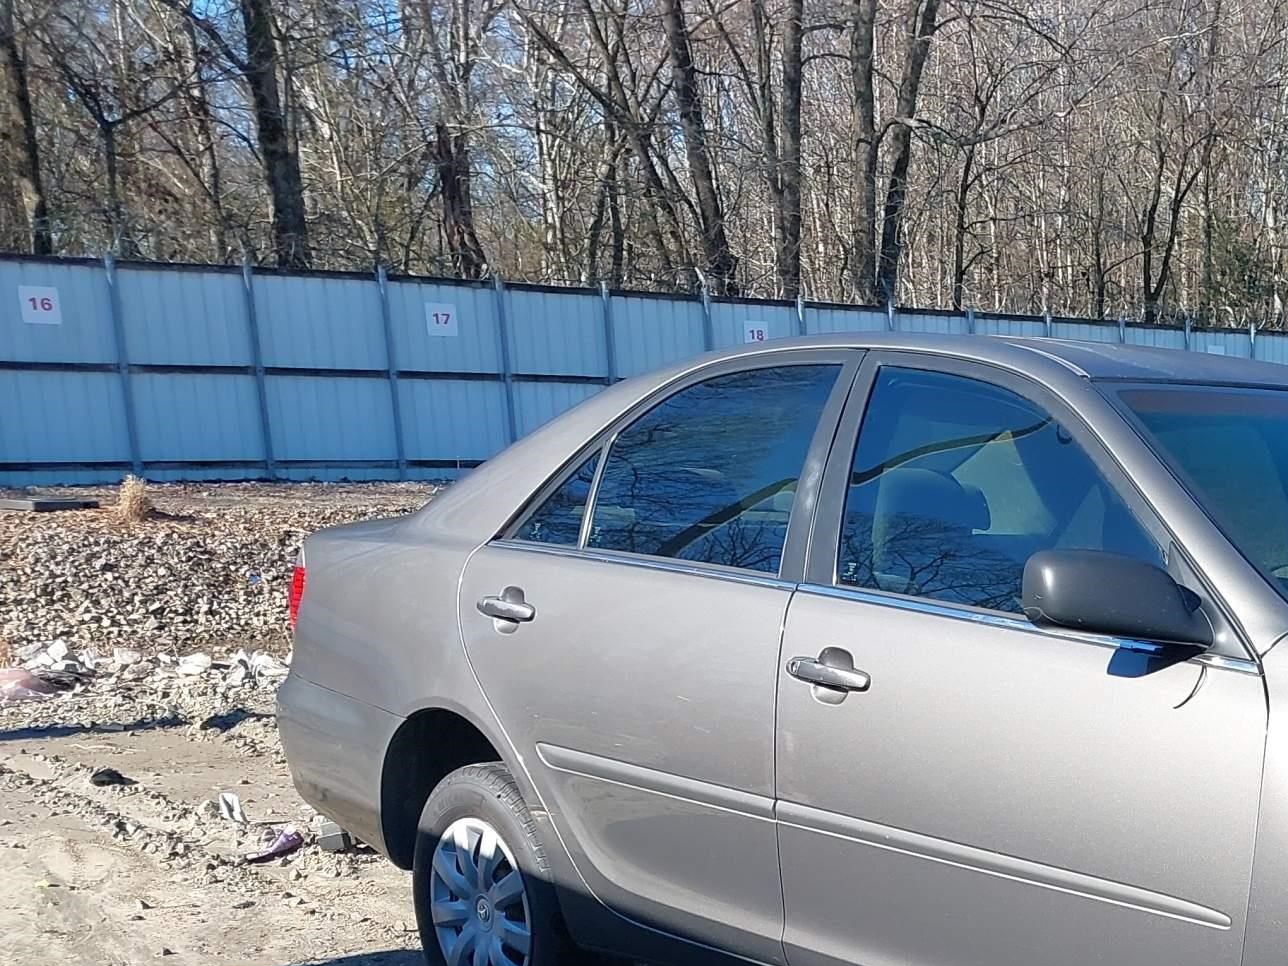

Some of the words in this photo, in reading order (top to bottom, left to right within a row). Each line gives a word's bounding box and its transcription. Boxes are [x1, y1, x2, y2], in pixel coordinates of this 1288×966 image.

[28, 297, 53, 311] 16
[432, 312, 450, 325] 17
[749, 329, 764, 341] 18
